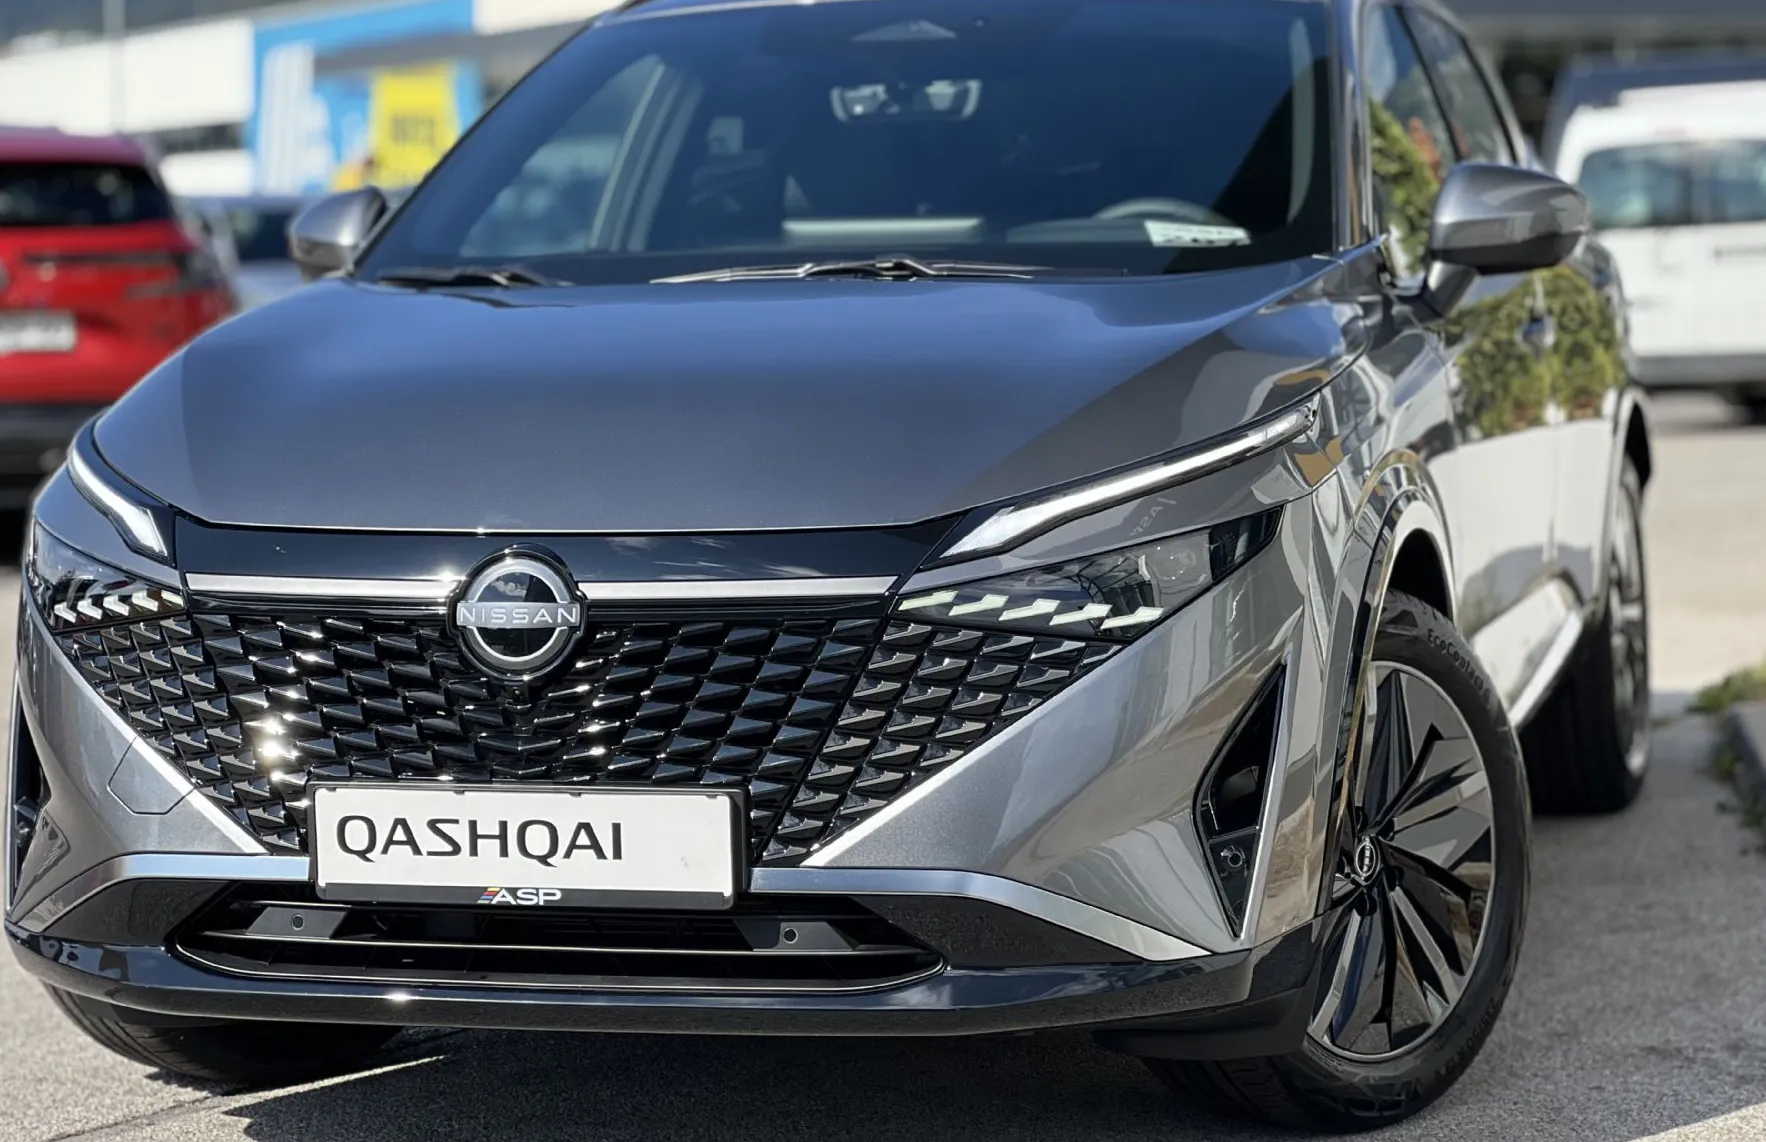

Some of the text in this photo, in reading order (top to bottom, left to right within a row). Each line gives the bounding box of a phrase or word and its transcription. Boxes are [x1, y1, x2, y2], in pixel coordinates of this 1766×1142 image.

[460, 607, 576, 624] NISSAN
[336, 815, 625, 867] QASHQAI
[491, 888, 562, 906] ASP
